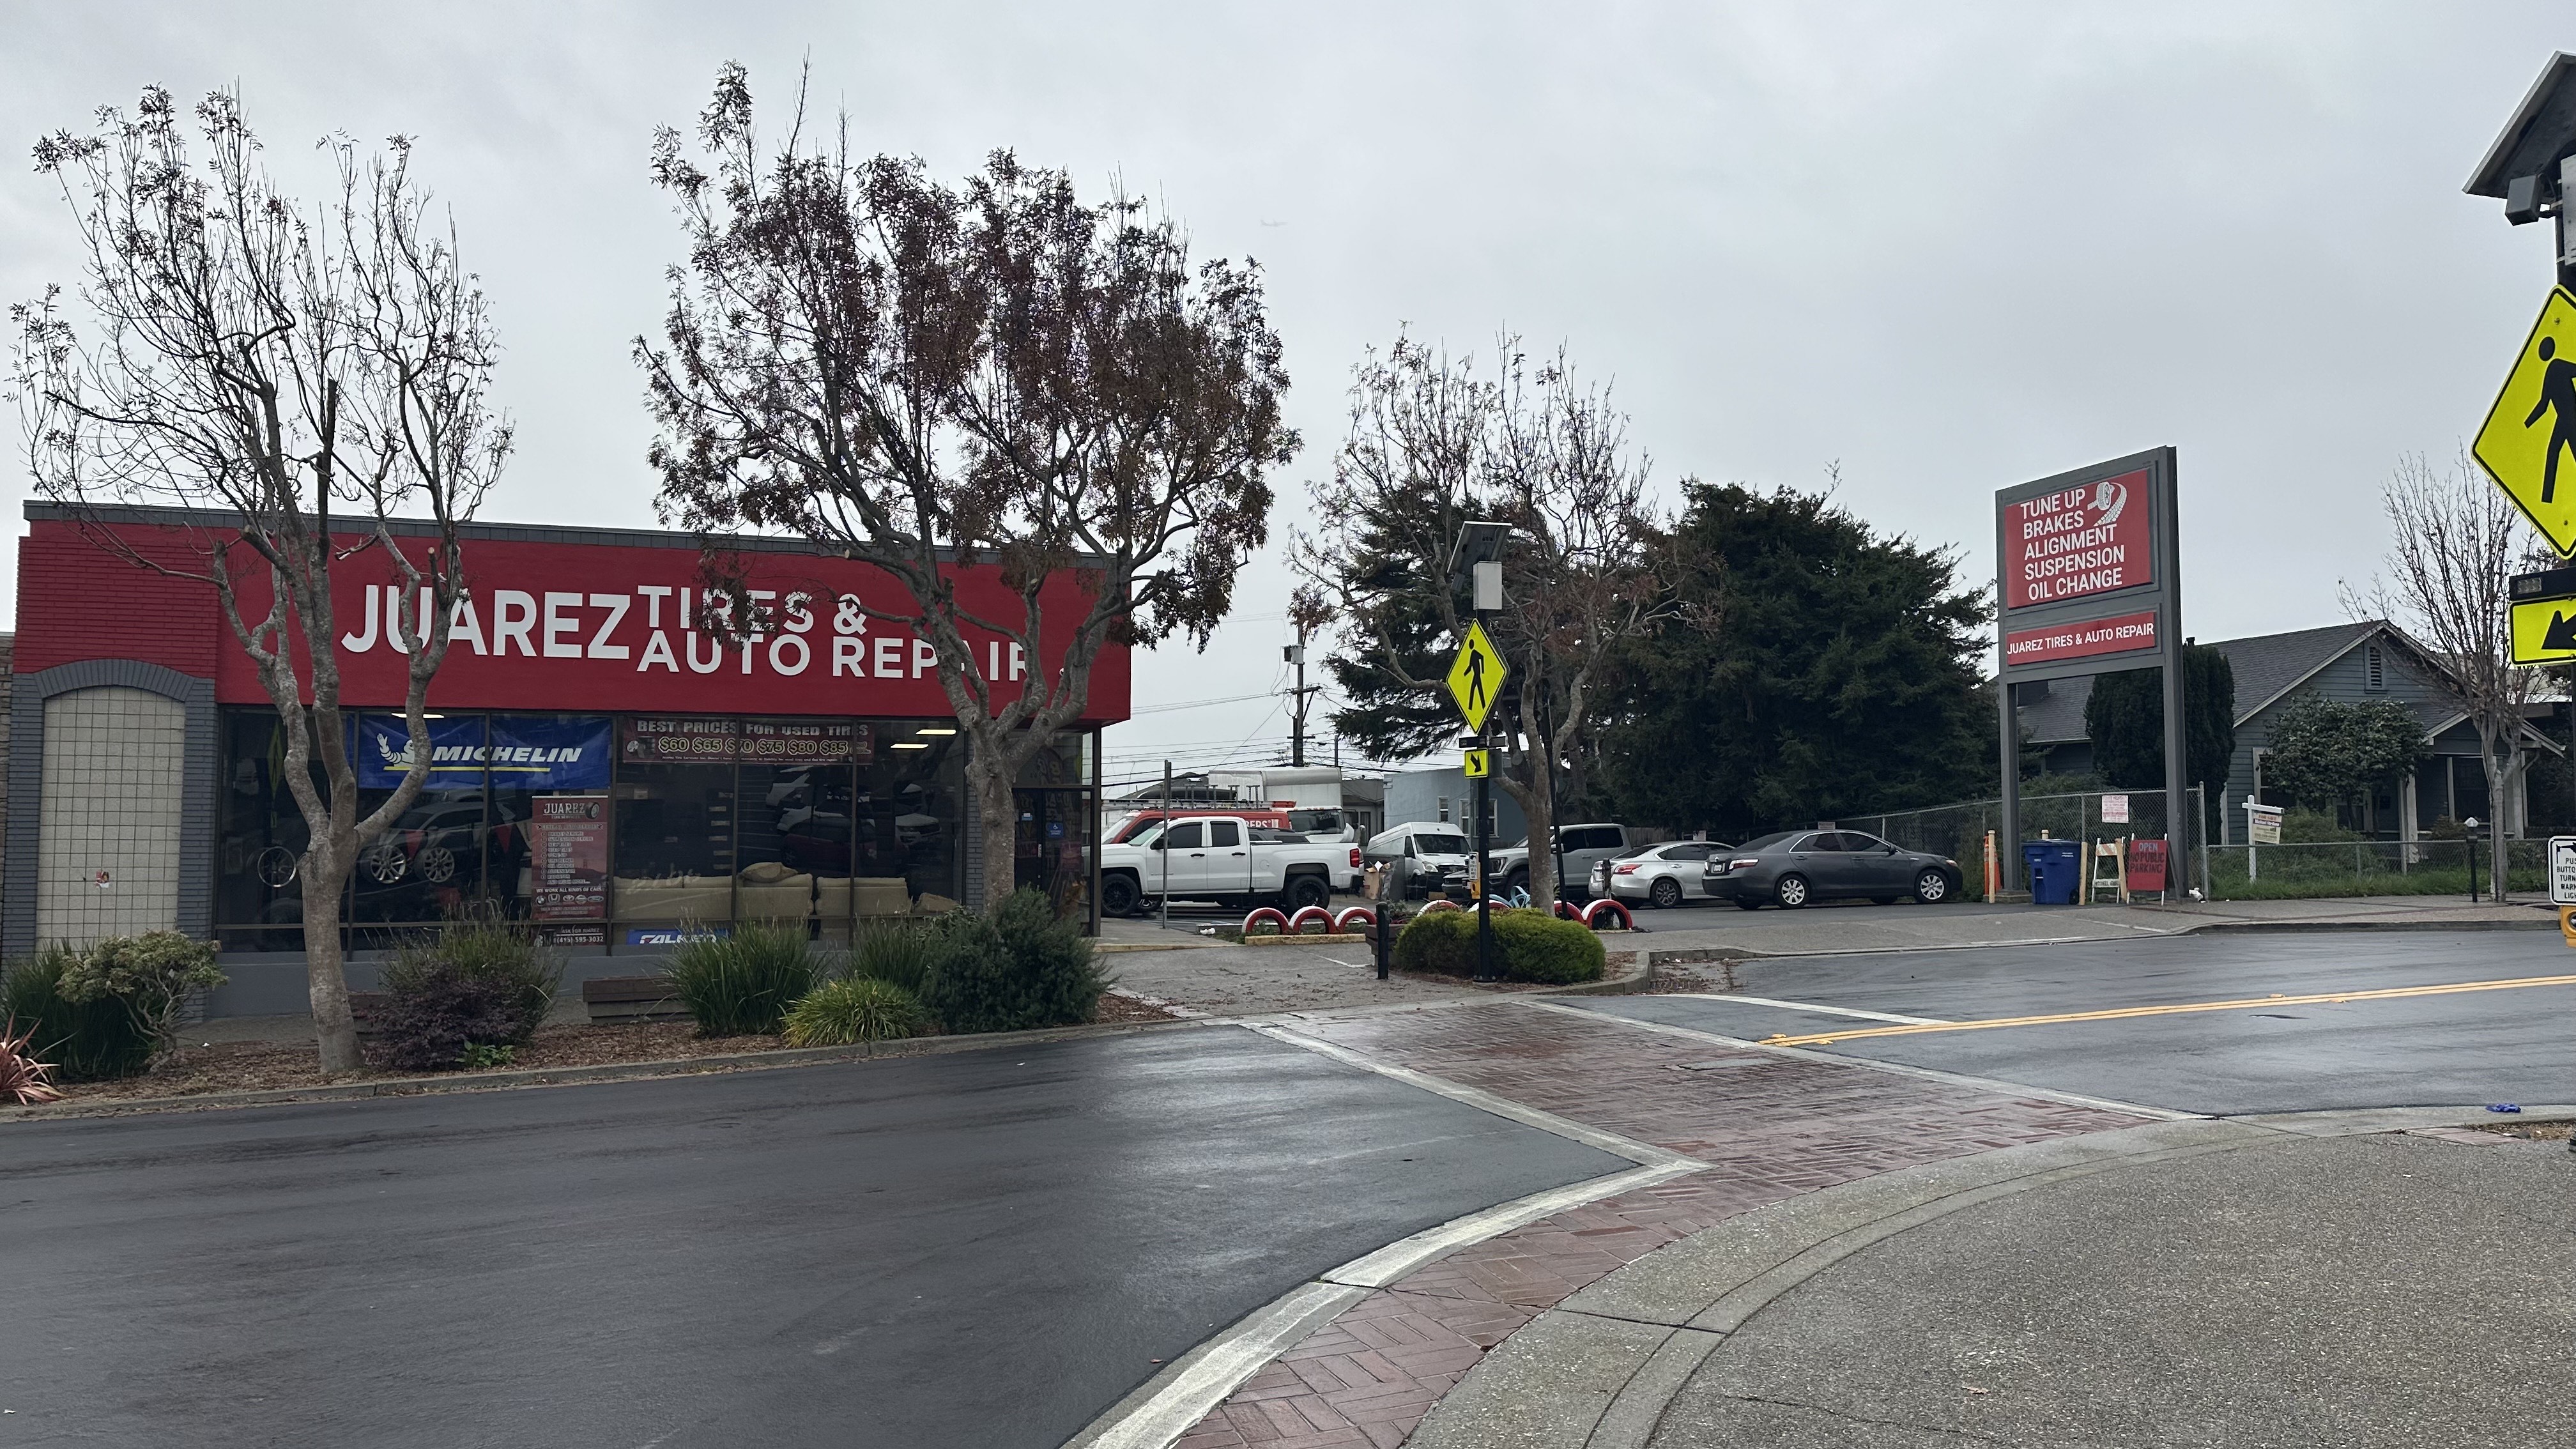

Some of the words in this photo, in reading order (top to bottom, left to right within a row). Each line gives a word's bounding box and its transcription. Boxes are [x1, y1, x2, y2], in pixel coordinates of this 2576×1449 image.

[2020, 494, 2060, 519] TUNE
[2064, 489, 2085, 508] UP
[2023, 510, 2084, 539] BRAKES
[2024, 523, 2117, 560] ALIGNMENT
[2025, 544, 2124, 580] SUSPENSION
[2028, 581, 2052, 601] OIL
[2056, 567, 2122, 595] CHANGE
[341, 584, 631, 659] JUAREZ
[638, 585, 814, 633] TIRES
[833, 594, 868, 634] &
[2007, 638, 2043, 655] JUAREZ
[2044, 634, 2073, 649] TIRES
[2075, 631, 2083, 645] &
[2085, 628, 2113, 644] AUTO
[2116, 622, 2154, 639] REPAIR
[637, 630, 810, 675] AUTO
[832, 636, 1027, 681] REPIR
[637, 720, 677, 732] BEST
[684, 721, 736, 733] PRICES
[746, 724, 774, 735] FOR
[781, 726, 820, 735] USED
[431, 746, 582, 762] MICHELIN
[659, 737, 689, 753] $60
[692, 737, 723, 753] $65
[756, 739, 785, 755] $75
[787, 739, 817, 755] $80
[819, 739, 848, 756] $85
[544, 802, 585, 814] JUAREZ
[2138, 842, 2158, 852] OPEN
[2140, 852, 2165, 863] PUBLIC
[2130, 863, 2163, 874] PARKING
